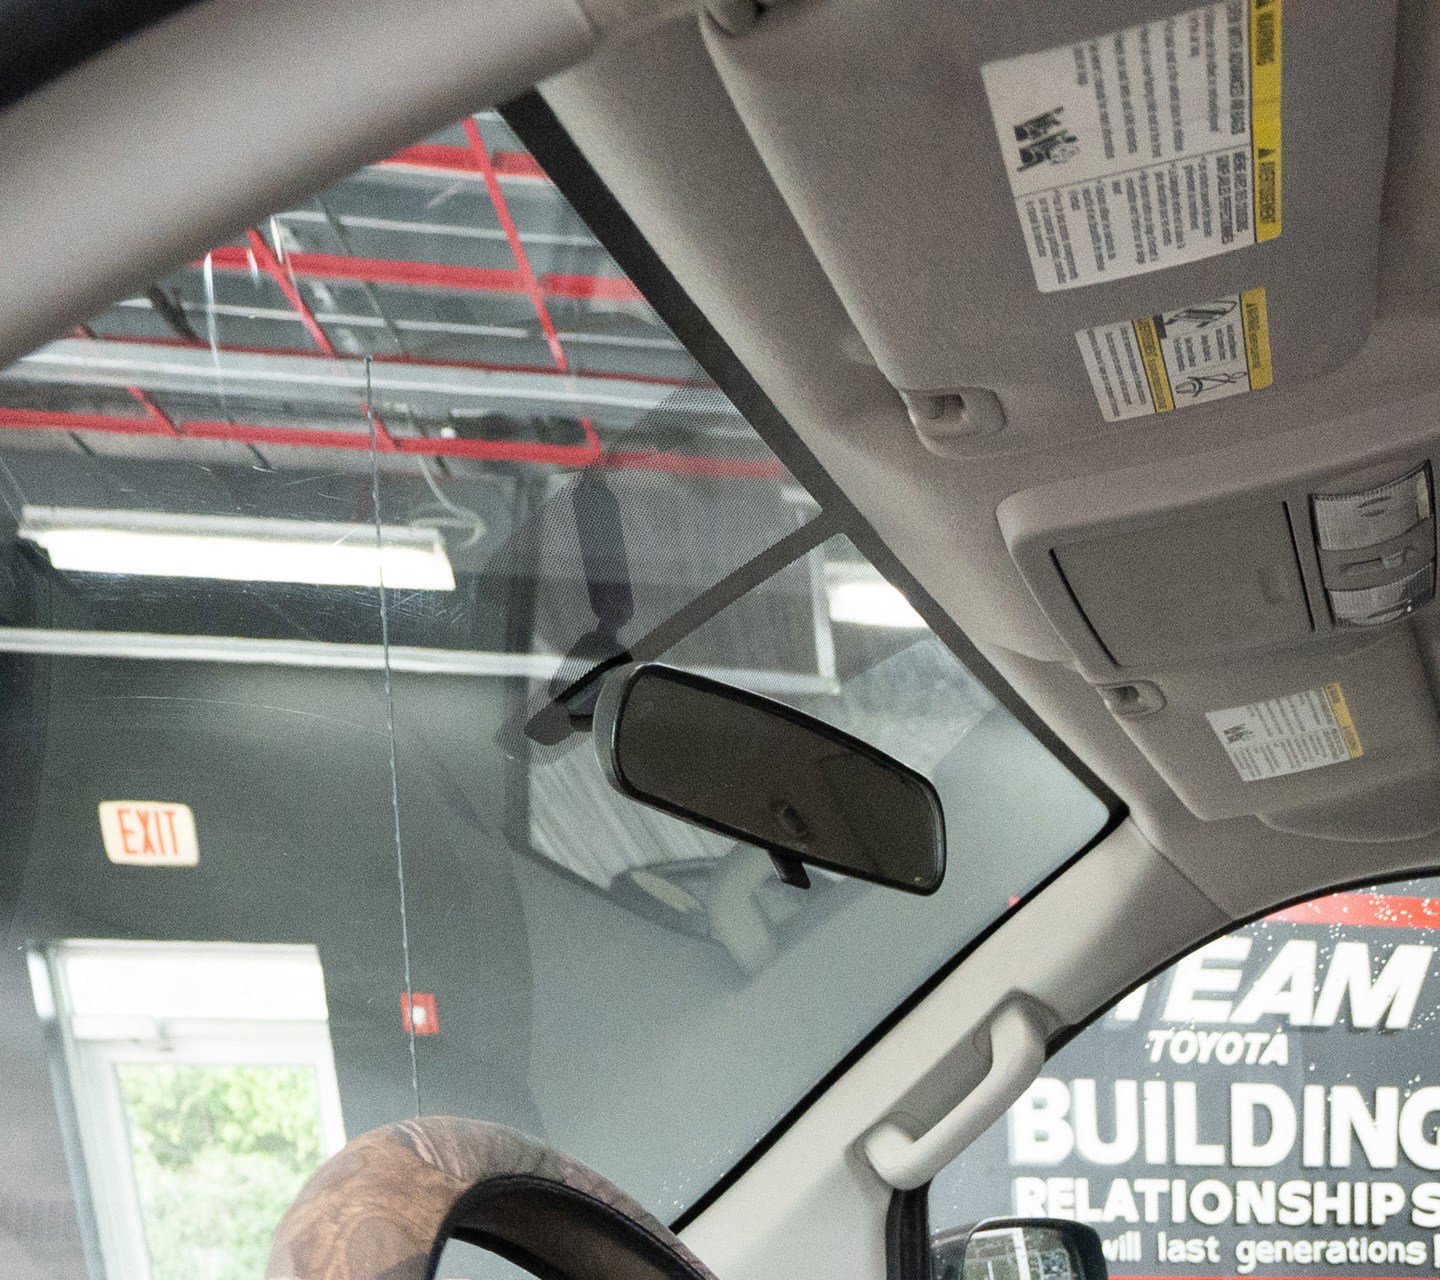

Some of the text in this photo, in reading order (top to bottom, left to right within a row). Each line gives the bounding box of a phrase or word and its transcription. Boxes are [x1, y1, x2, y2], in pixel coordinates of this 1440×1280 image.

[117, 809, 178, 856] EXIT
[1114, 936, 1434, 1029] EAM
[1148, 1030, 1289, 1066] TOYOTA
[1158, 1232, 1219, 1263] last
